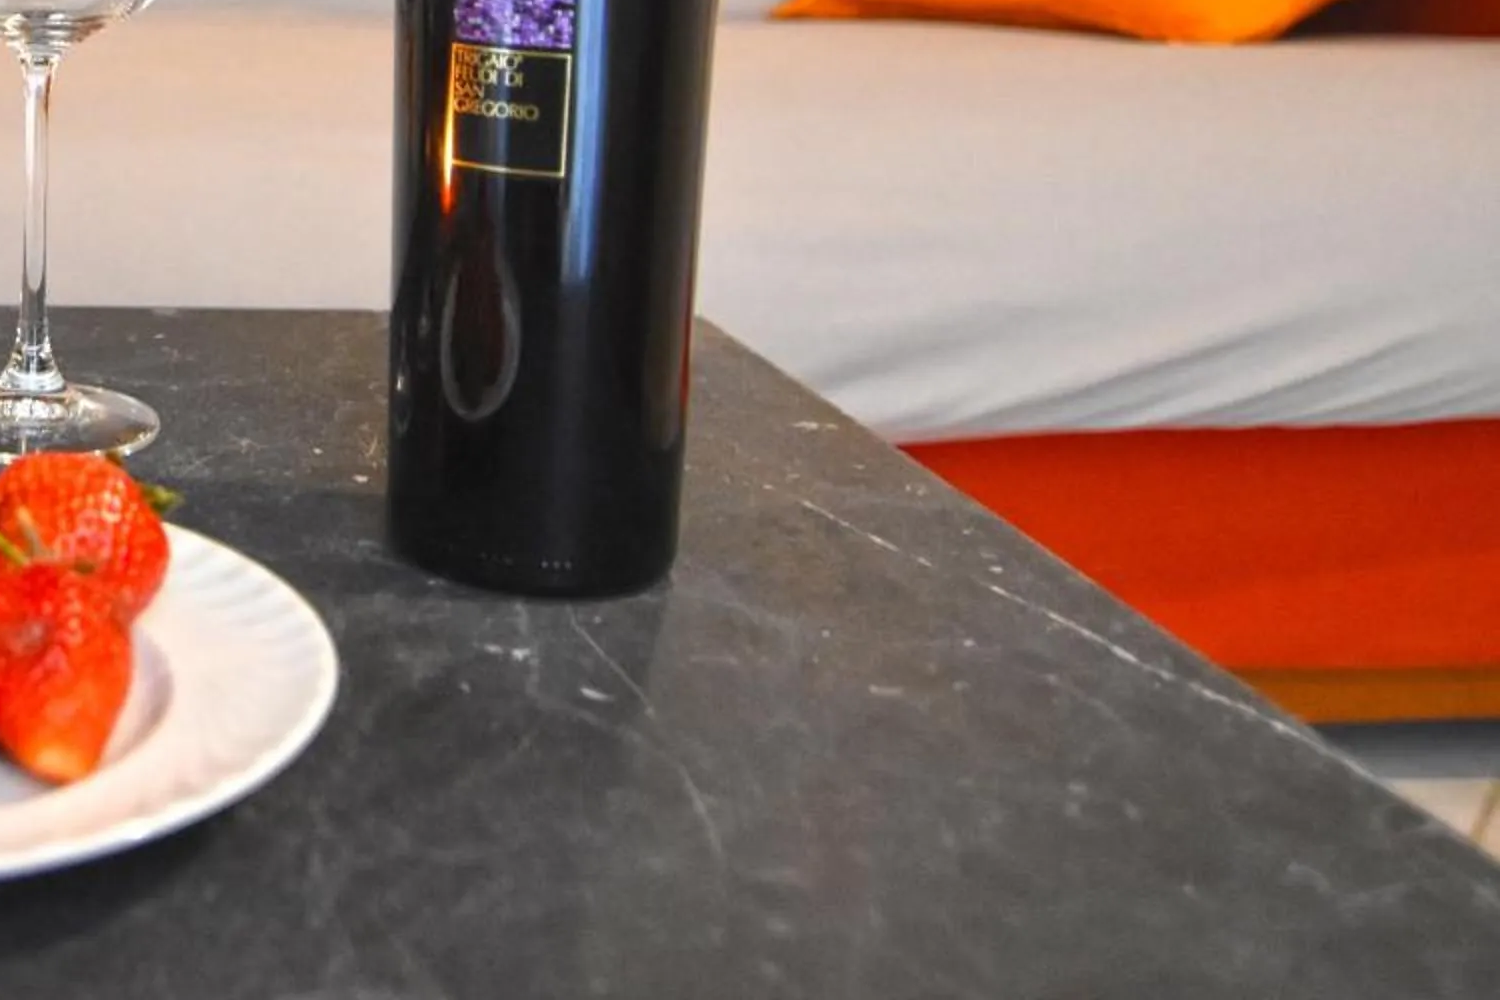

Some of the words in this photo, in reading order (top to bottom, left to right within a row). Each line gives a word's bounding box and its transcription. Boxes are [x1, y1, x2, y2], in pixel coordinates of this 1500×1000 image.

[504, 69, 523, 87] DI
[454, 81, 485, 99] SAN
[454, 98, 539, 120] GREGORIO
